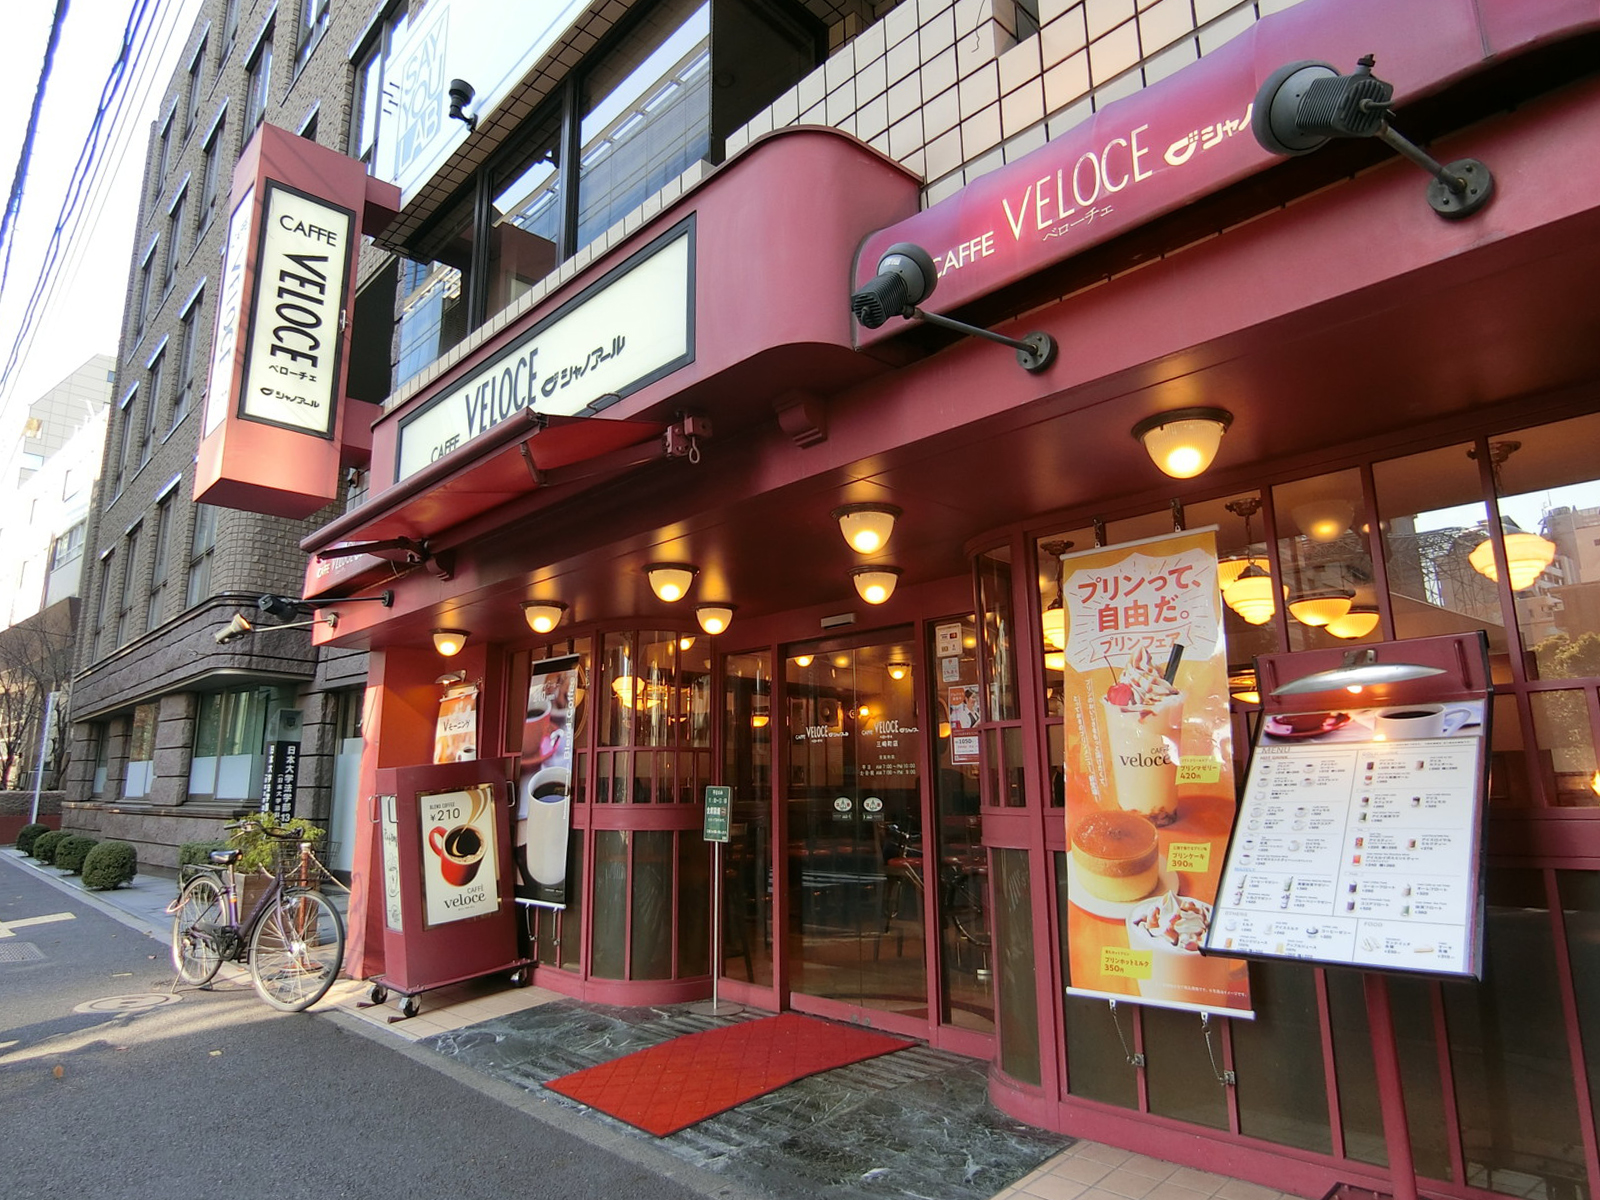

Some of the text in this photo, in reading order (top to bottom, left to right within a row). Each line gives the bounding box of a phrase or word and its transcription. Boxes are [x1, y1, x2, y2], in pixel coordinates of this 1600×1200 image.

[1001, 124, 1153, 242] VELOCE
[279, 214, 338, 247] CAFFE
[1042, 204, 1114, 242] ベローチェ
[270, 253, 329, 369] VELOCE
[268, 364, 317, 383] ベローチェ
[560, 335, 626, 389] シャノアール
[465, 347, 539, 438] VELOCE
[1077, 564, 1201, 604] プリンって、
[1097, 594, 1190, 632] 自由だ。
[1100, 631, 1181, 654] プリンフェア
[566, 676, 577, 722] Coffee
[563, 722, 573, 760] Blend
[805, 725, 828, 738] VELOCE
[874, 720, 899, 734] VELOCE
[1120, 753, 1172, 768] veloce
[430, 807, 461, 821] ¥210
[443, 892, 486, 909] veloce
